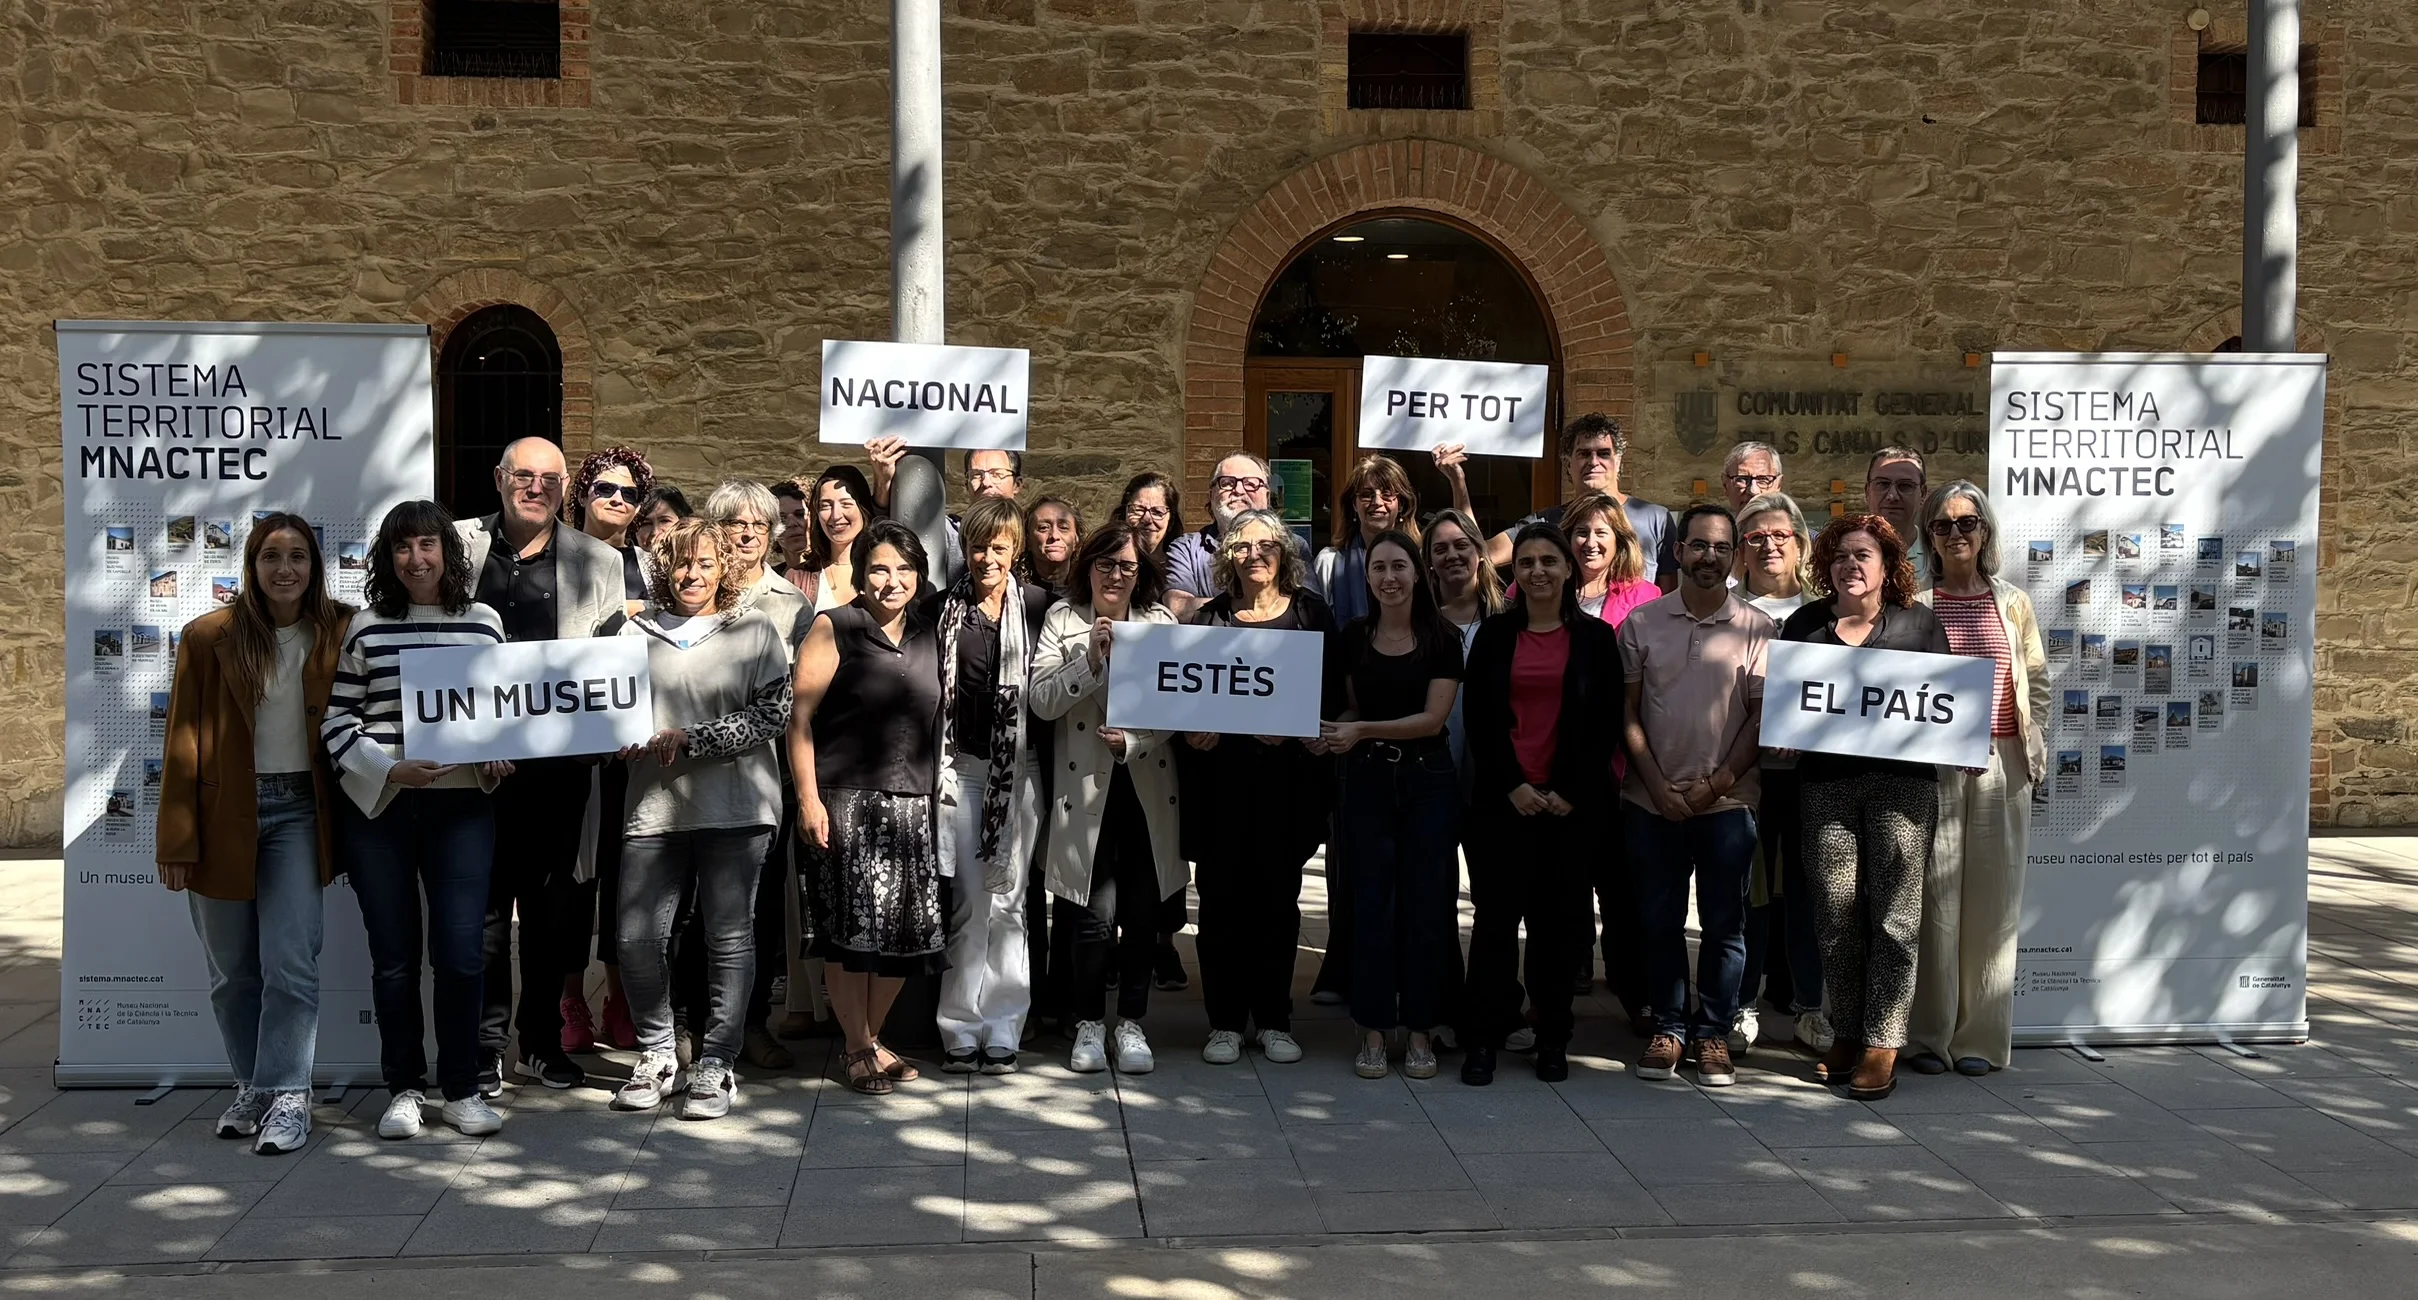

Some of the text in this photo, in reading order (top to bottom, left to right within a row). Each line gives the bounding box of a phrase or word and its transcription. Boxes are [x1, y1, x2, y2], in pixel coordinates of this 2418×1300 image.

[77, 363, 248, 398] SISTEMA
[831, 376, 1018, 414] NACIONAL
[1387, 390, 1522, 423] PER TOT
[1737, 391, 1984, 416] COMUNITAT GENERAL
[2006, 391, 2160, 421] SISTEMA
[77, 404, 342, 440] TERRITORIAL
[2005, 429, 2244, 459] TERRITORIAL
[80, 446, 268, 481] MNACTEC
[2006, 466, 2175, 496] MNACTEC
[1157, 657, 1275, 697] ESTÈS
[416, 676, 637, 723] UN MUSEU
[1800, 681, 1955, 724] EL PAÍS
[2070, 852, 2124, 864] nacional
[2128, 851, 2163, 864] estès
[2167, 853, 2188, 865] per
[2192, 852, 2208, 863] tot
[2212, 851, 2223, 863] el
[2227, 850, 2254, 864] país
[80, 871, 99, 884] Un
[105, 874, 154, 884] museu
[79, 975, 164, 983] sistema.mnactec.cat
